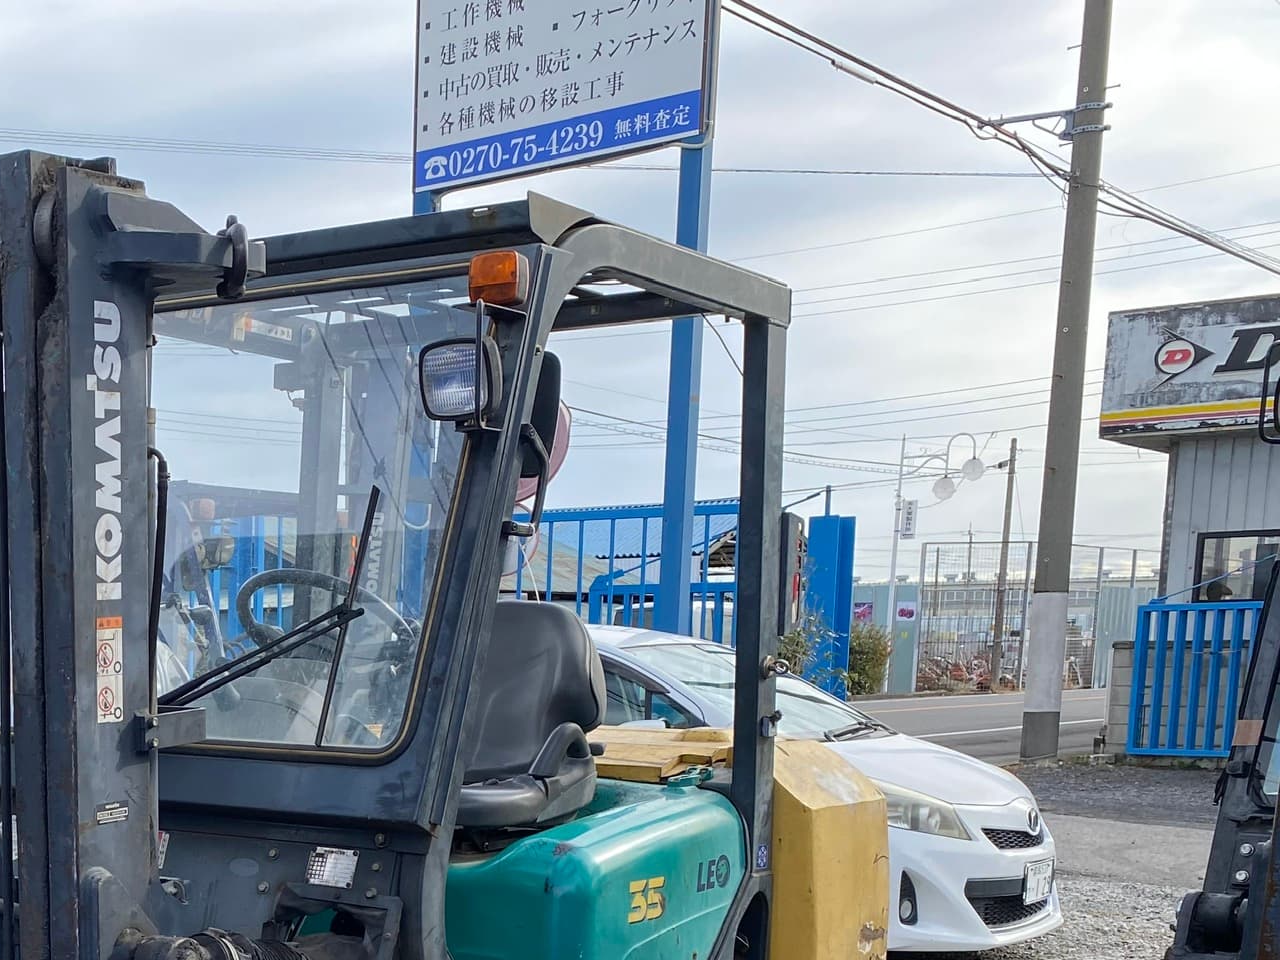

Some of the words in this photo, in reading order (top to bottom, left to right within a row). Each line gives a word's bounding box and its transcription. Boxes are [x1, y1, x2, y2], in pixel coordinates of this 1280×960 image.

[440, 0, 524, 32] 工作機械
[440, 25, 524, 67] 建設機械
[439, 19, 697, 101] 中古の買取・販売・メンテナンス
[439, 71, 625, 136] 各種機械の移設工事
[448, 120, 603, 177] 0270-75-4239
[614, 105, 690, 139] 無料査定
[86, 300, 122, 600] KOMATSU
